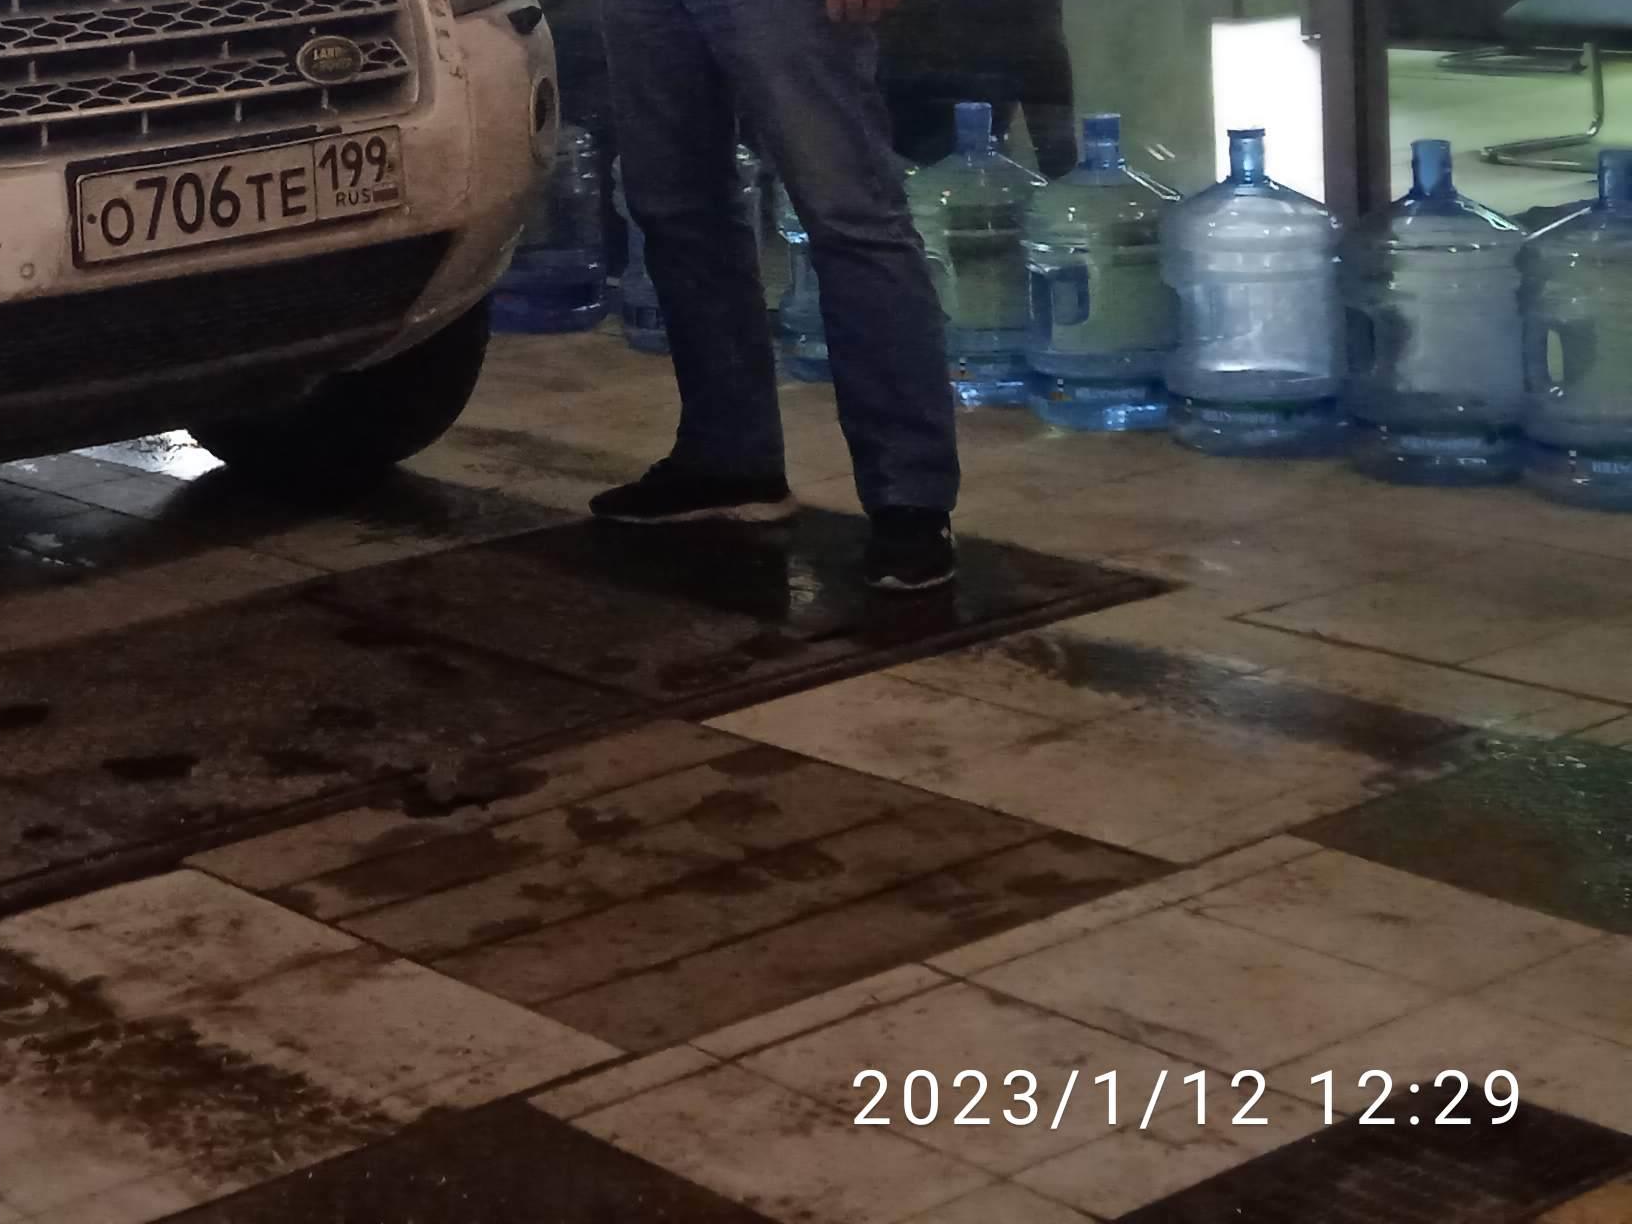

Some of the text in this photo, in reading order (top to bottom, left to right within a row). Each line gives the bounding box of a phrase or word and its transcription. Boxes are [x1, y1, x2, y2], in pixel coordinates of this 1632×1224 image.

[319, 135, 387, 191] 199
[100, 165, 307, 247] O706TE
[335, 190, 372, 208] RUS
